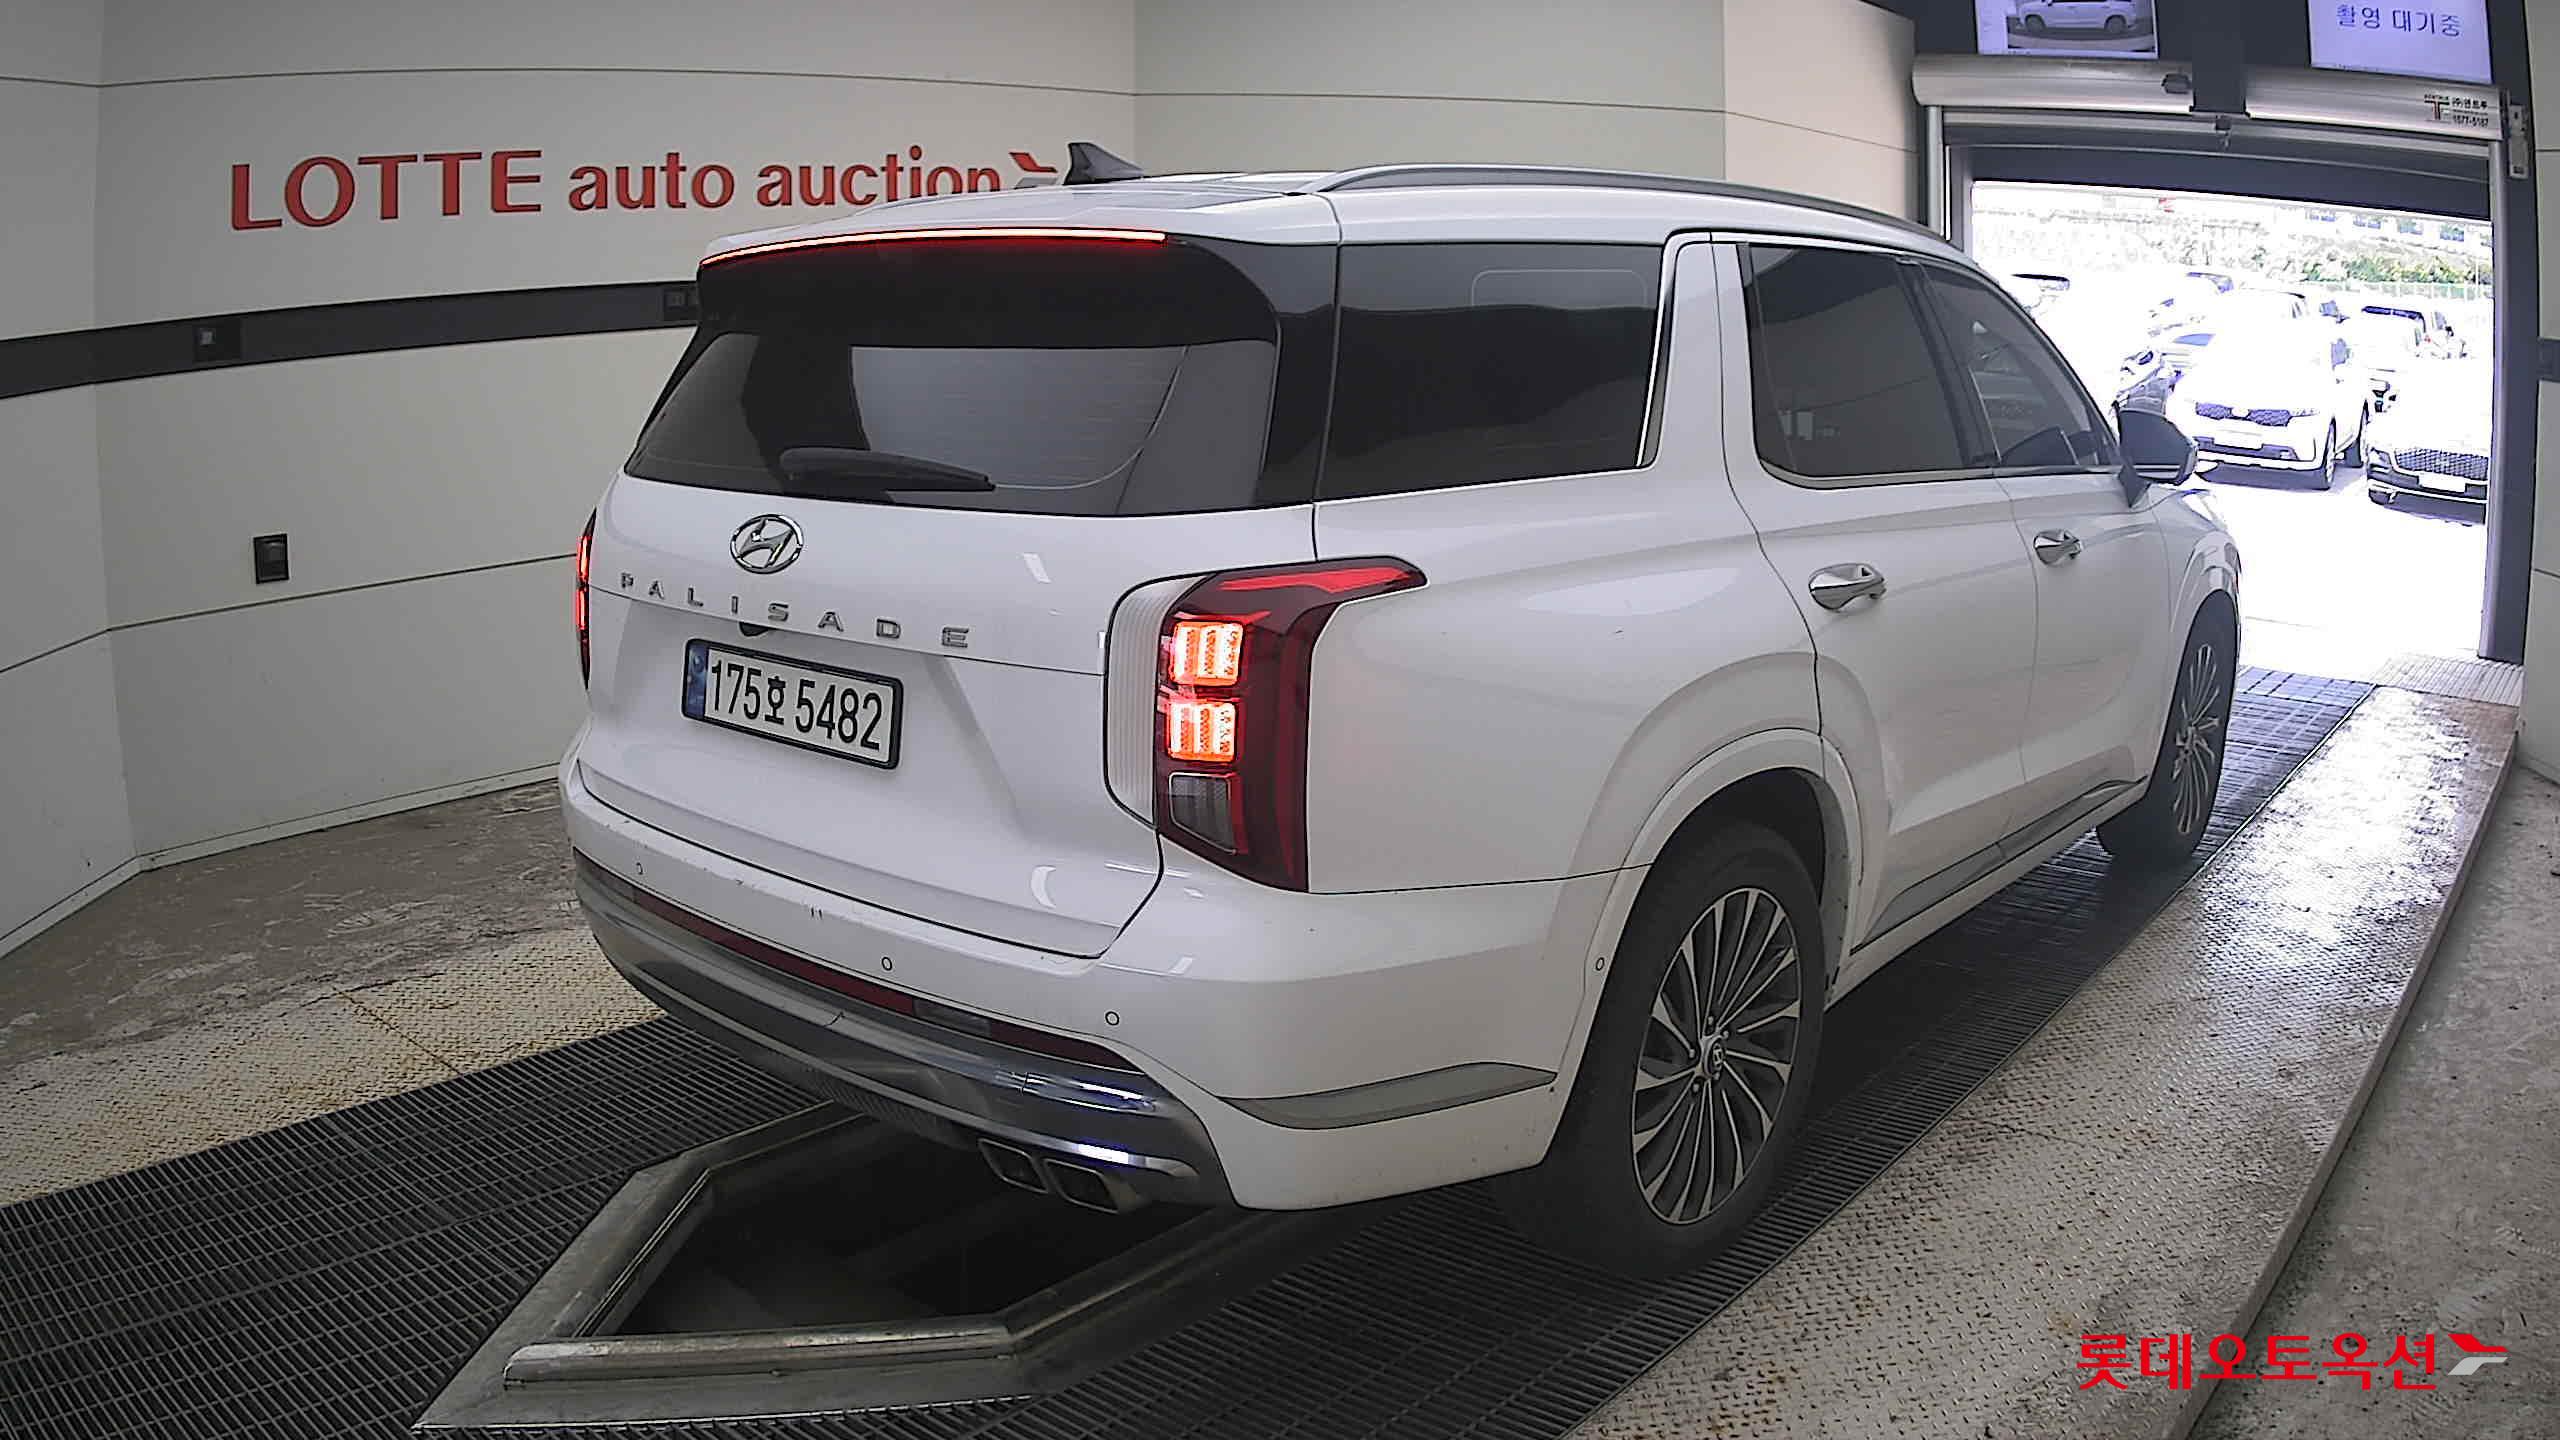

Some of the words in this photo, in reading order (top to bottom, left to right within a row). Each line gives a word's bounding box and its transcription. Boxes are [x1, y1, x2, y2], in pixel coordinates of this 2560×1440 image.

[2392, 9, 2461, 37] 대기중
[230, 149, 543, 232] LOTTE
[568, 152, 736, 210] auto
[756, 144, 1002, 207] auction
[620, 571, 972, 650] PALISADE
[711, 659, 787, 726] 175호
[794, 678, 882, 752] 5482
